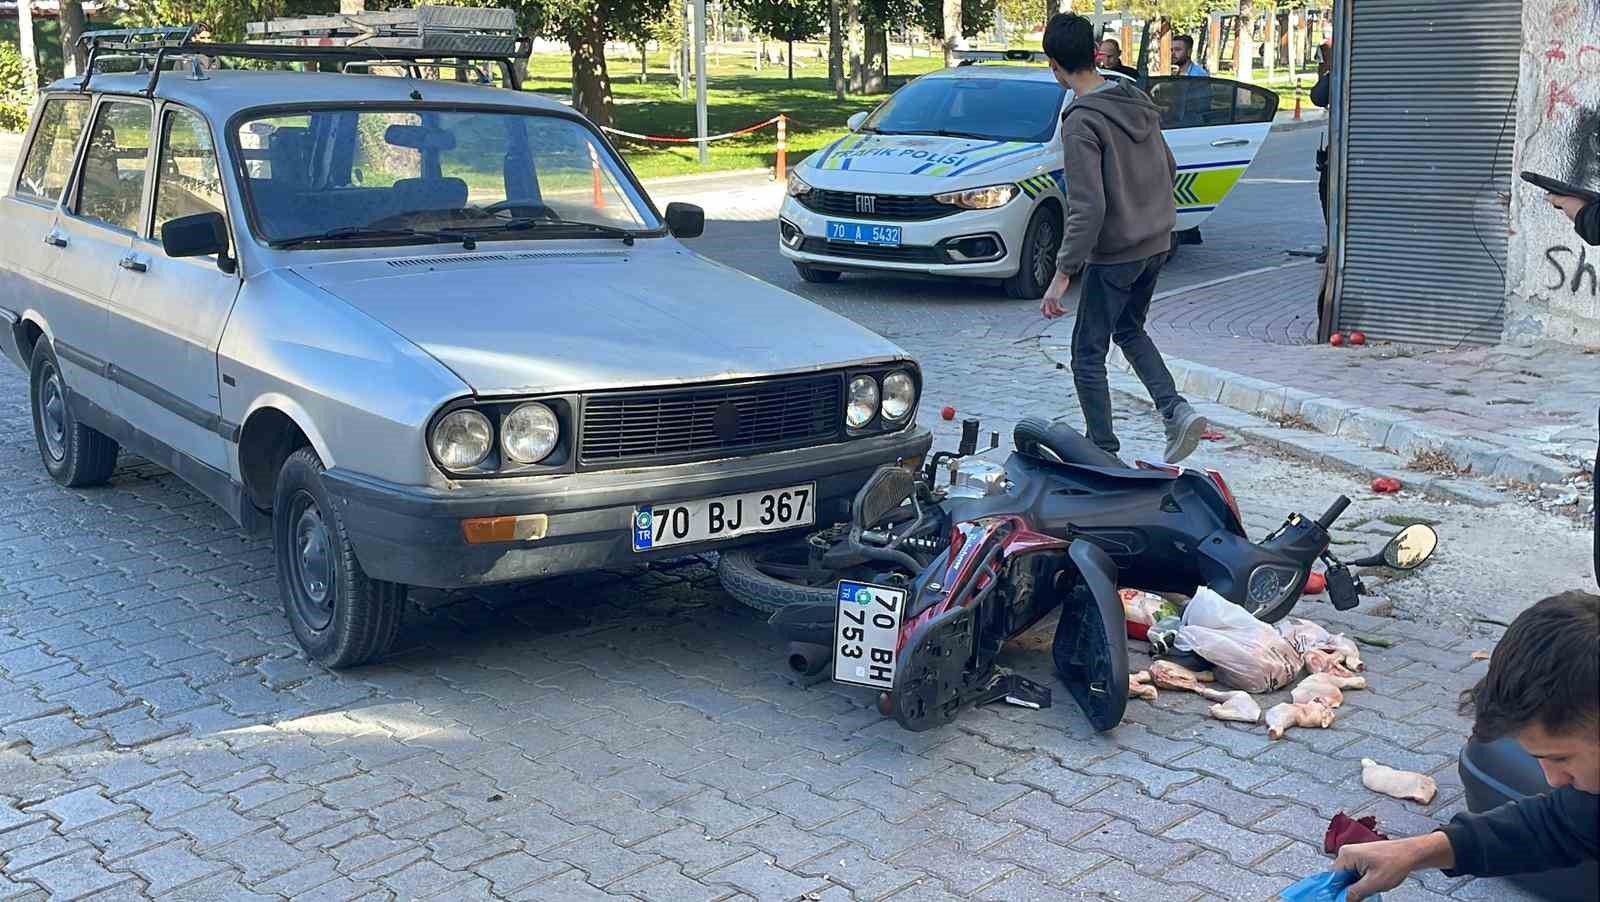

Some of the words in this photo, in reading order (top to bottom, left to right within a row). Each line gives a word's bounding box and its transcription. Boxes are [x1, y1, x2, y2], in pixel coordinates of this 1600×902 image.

[855, 194, 876, 213] FIAT
[833, 224, 845, 238] 70
[856, 225, 862, 240] A
[873, 226, 898, 242] 5432
[653, 507, 689, 542] 70
[709, 499, 742, 534] BJ
[760, 489, 809, 525] 367
[638, 530, 651, 541] TR
[842, 587, 851, 600] TR
[872, 595, 898, 630] 70
[840, 609, 866, 659] 753
[869, 647, 893, 682] BH
